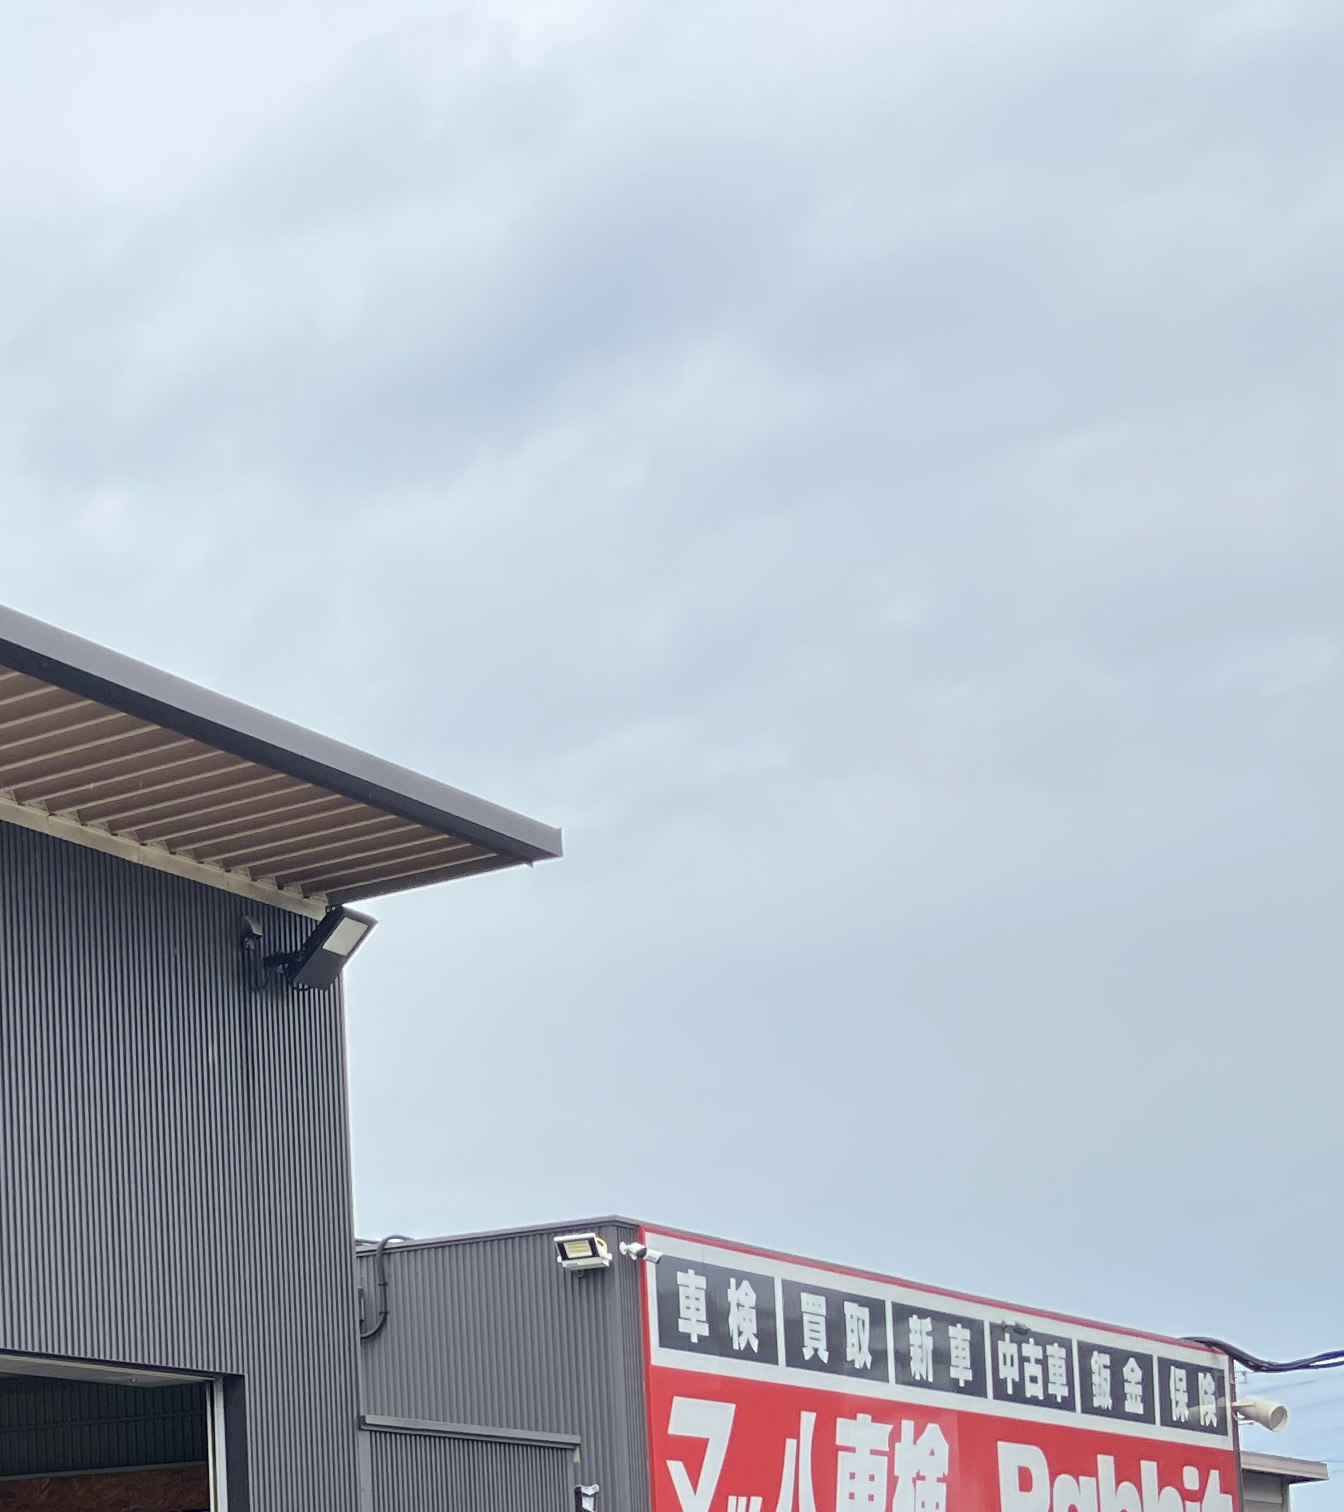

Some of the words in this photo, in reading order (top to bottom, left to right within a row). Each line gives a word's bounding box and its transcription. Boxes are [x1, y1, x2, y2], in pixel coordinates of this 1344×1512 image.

[676, 1269, 759, 1353] 車検
[800, 1291, 872, 1370] 買取
[909, 1313, 973, 1387] 新車
[997, 1332, 1069, 1402] 中古車
[1168, 1365, 1217, 1428] 保険
